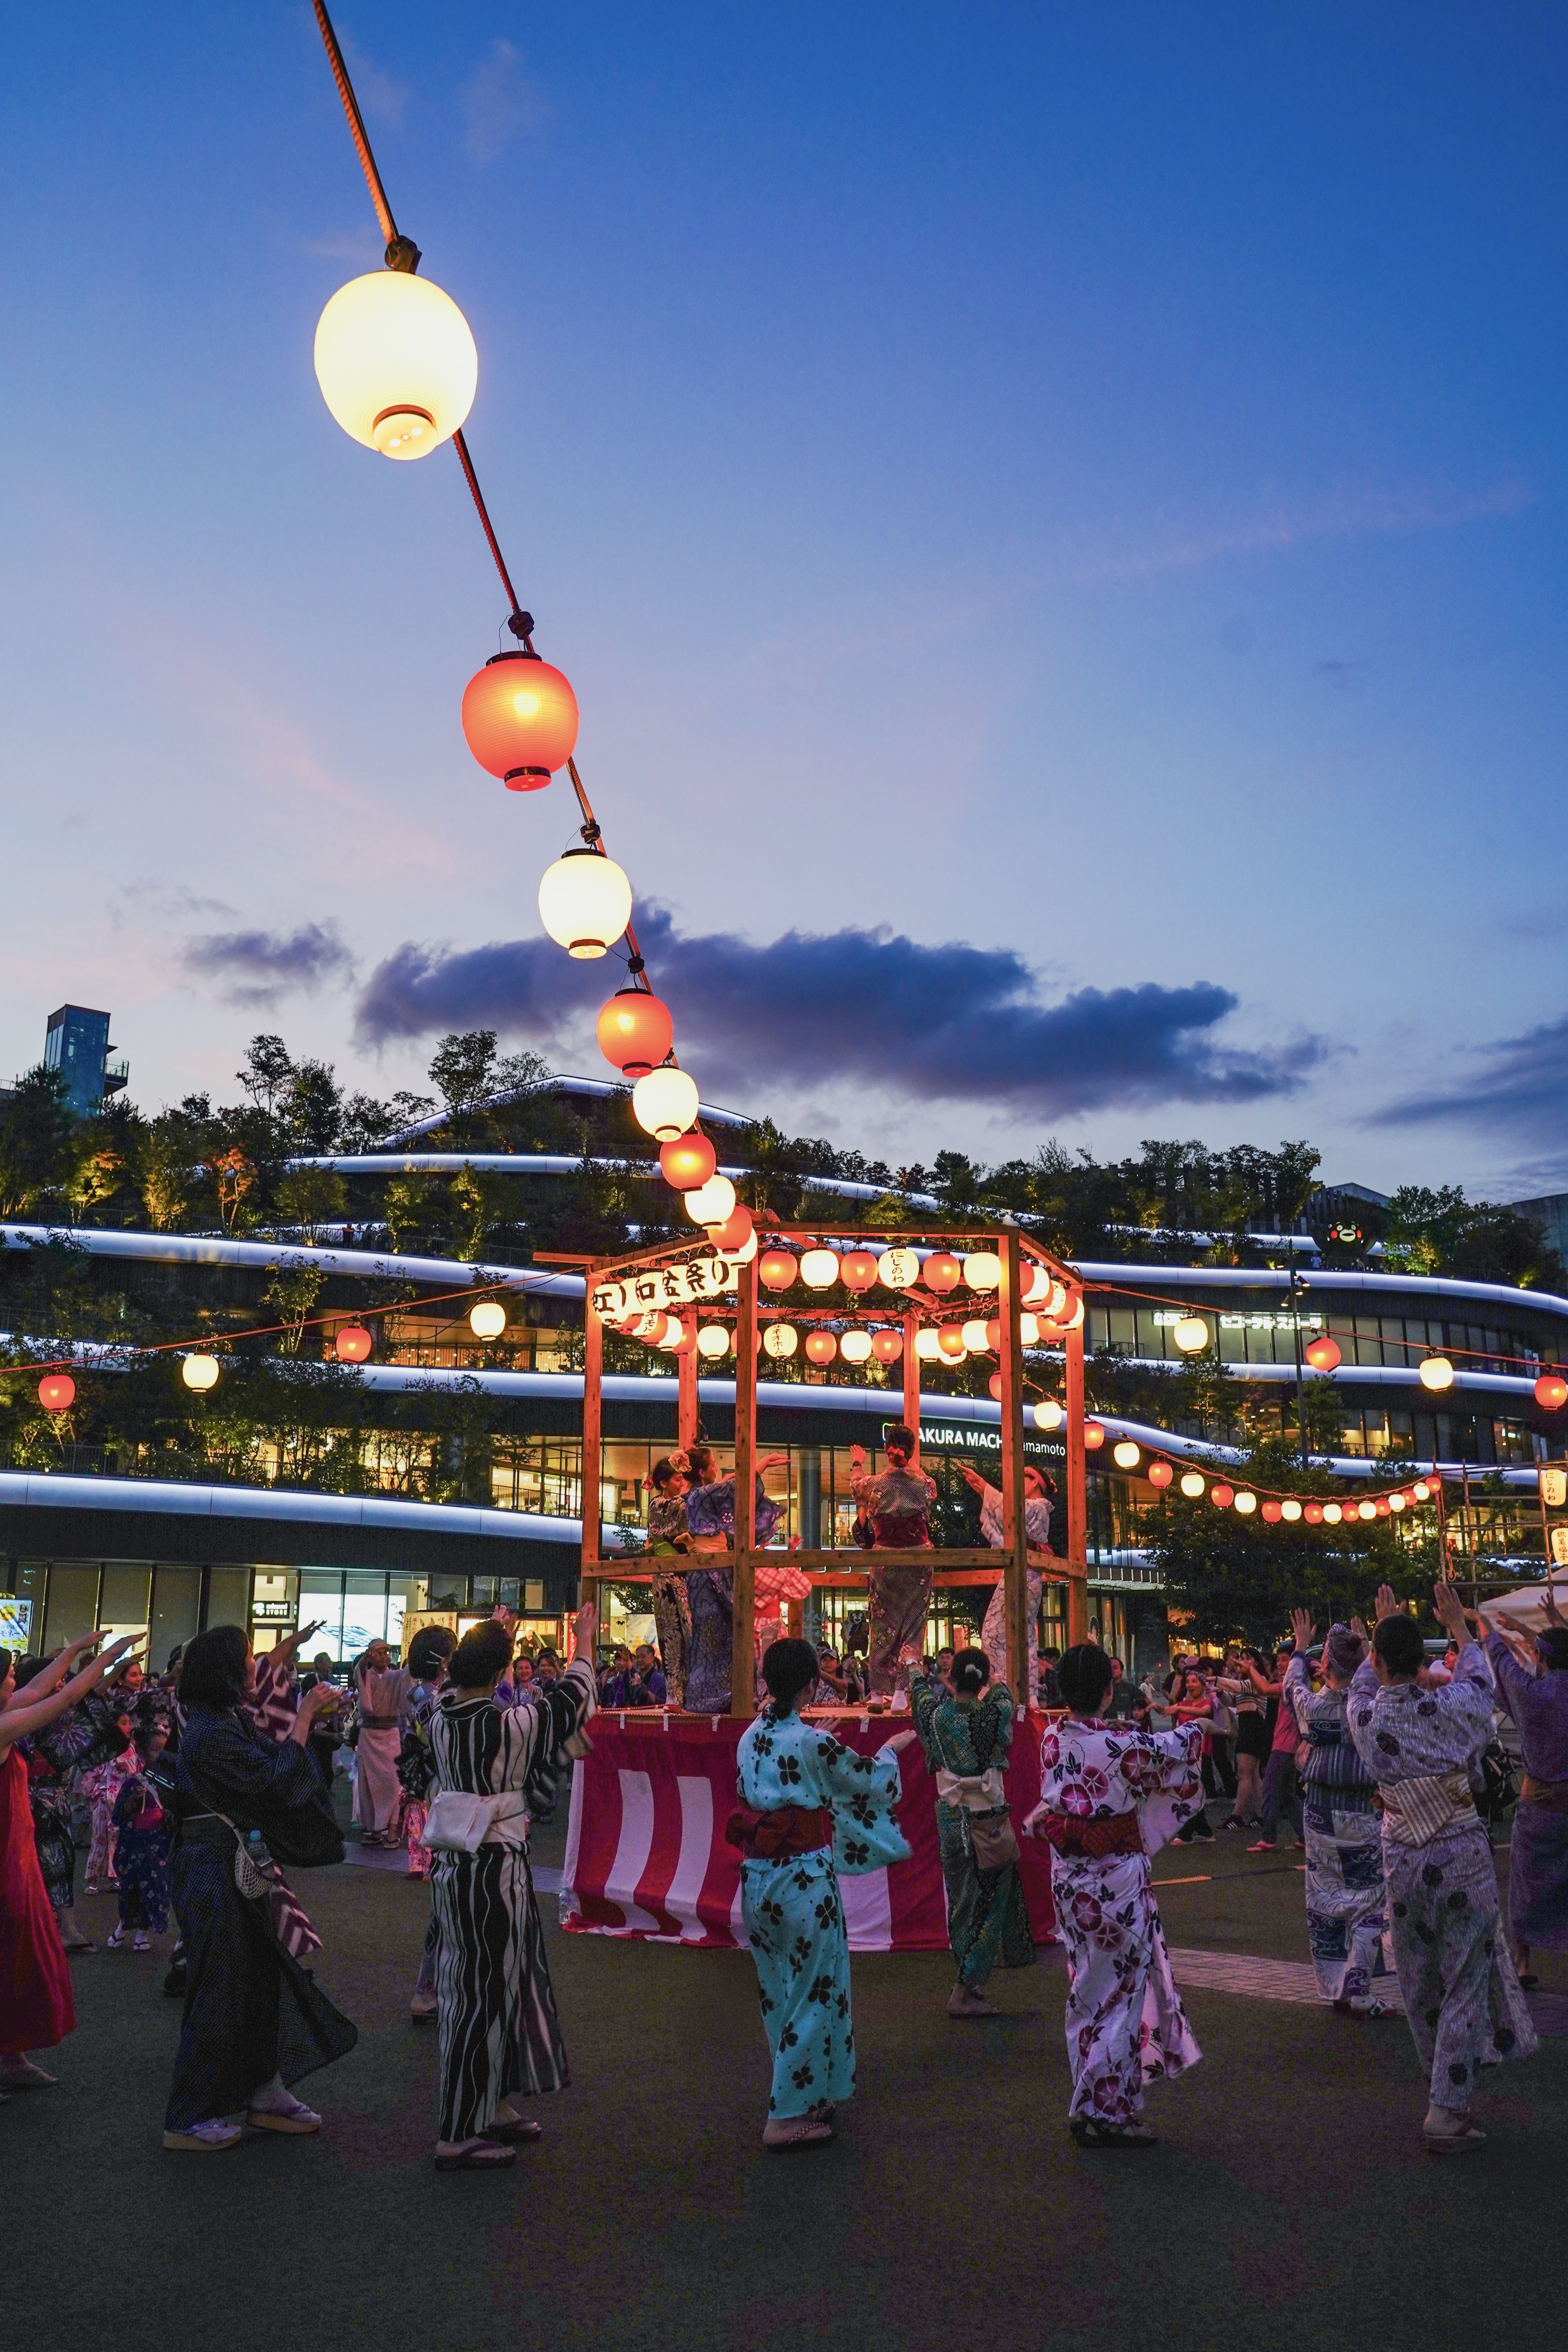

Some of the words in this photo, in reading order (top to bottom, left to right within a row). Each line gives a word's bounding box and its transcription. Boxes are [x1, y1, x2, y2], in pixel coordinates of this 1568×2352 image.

[891, 1252, 904, 1283] にじのわ
[919, 1427, 964, 1445] AKURA
[967, 1431, 1003, 1449] MACH
[1023, 1442, 1066, 1456] mamoto
[1546, 1473, 1556, 1501] にじのわ
